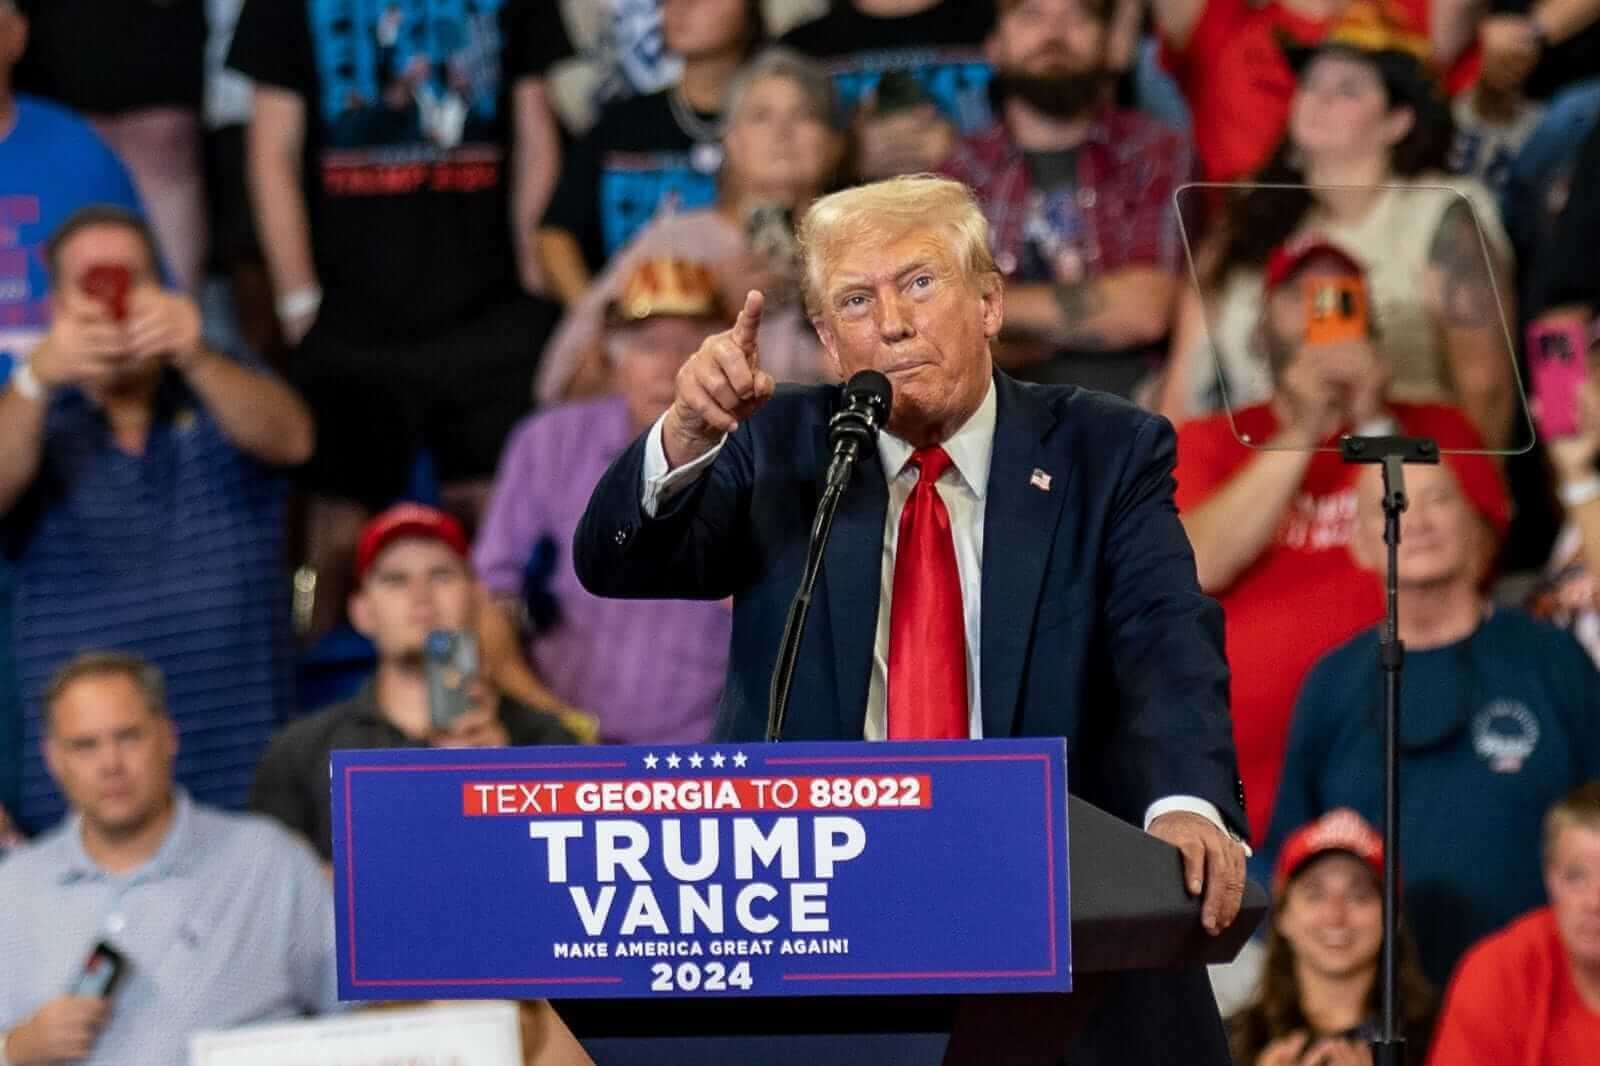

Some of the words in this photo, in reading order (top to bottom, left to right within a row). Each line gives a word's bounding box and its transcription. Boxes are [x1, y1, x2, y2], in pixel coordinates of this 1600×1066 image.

[474, 784, 564, 813] TEXT
[576, 780, 742, 811] GEORGIA
[751, 779, 799, 809] TO
[810, 777, 921, 808] 88022
[529, 816, 867, 883] TRUMP
[569, 883, 830, 936] VANCE
[553, 943, 609, 958] MAKE
[615, 941, 704, 957] AMERICA
[709, 940, 774, 956] GREAT
[780, 938, 849, 955] AGAIN!
[651, 962, 753, 991] 2024
